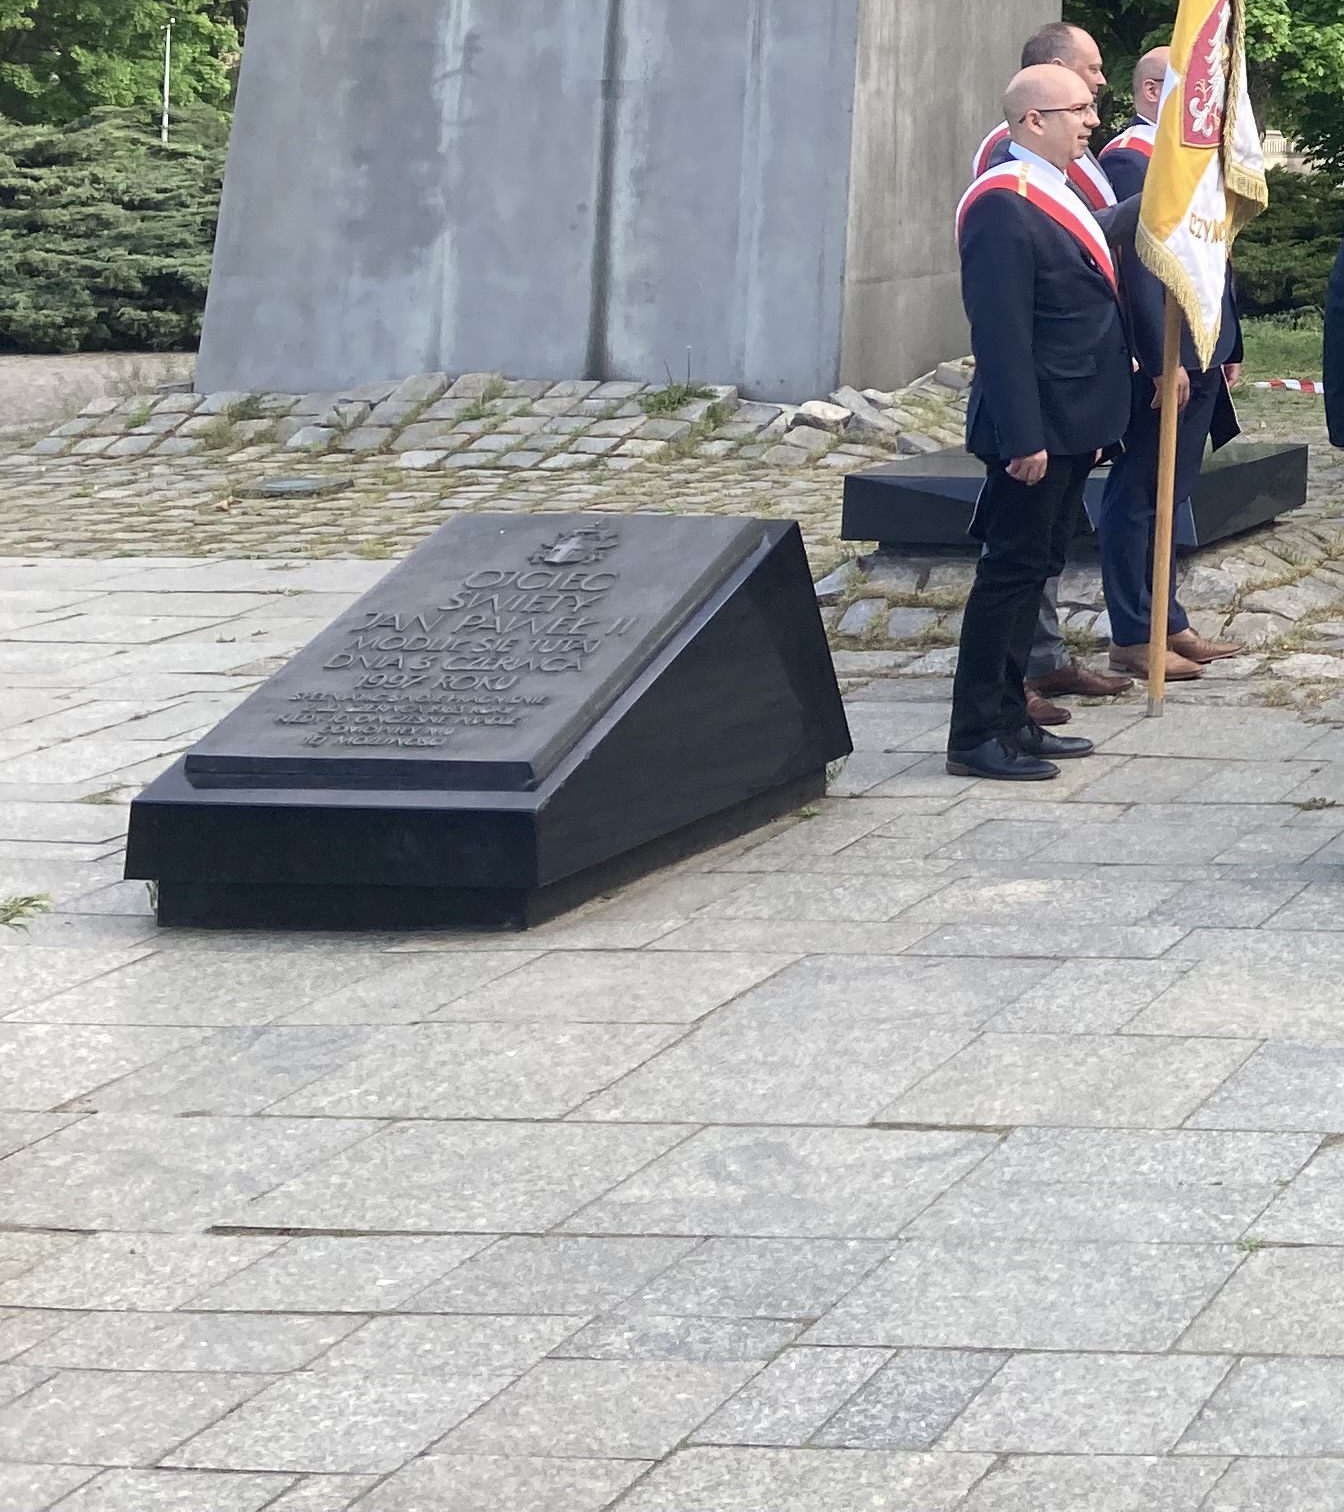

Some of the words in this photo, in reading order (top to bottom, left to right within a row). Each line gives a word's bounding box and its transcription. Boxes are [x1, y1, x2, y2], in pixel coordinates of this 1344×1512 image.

[463, 570, 620, 592] OJCIEC
[350, 612, 444, 634] JAN
[451, 613, 600, 637] PAWEŁ
[322, 653, 405, 671] DNIA
[441, 655, 584, 674] CZERWCA
[354, 673, 426, 690] 1997
[434, 674, 521, 691] ROKU
